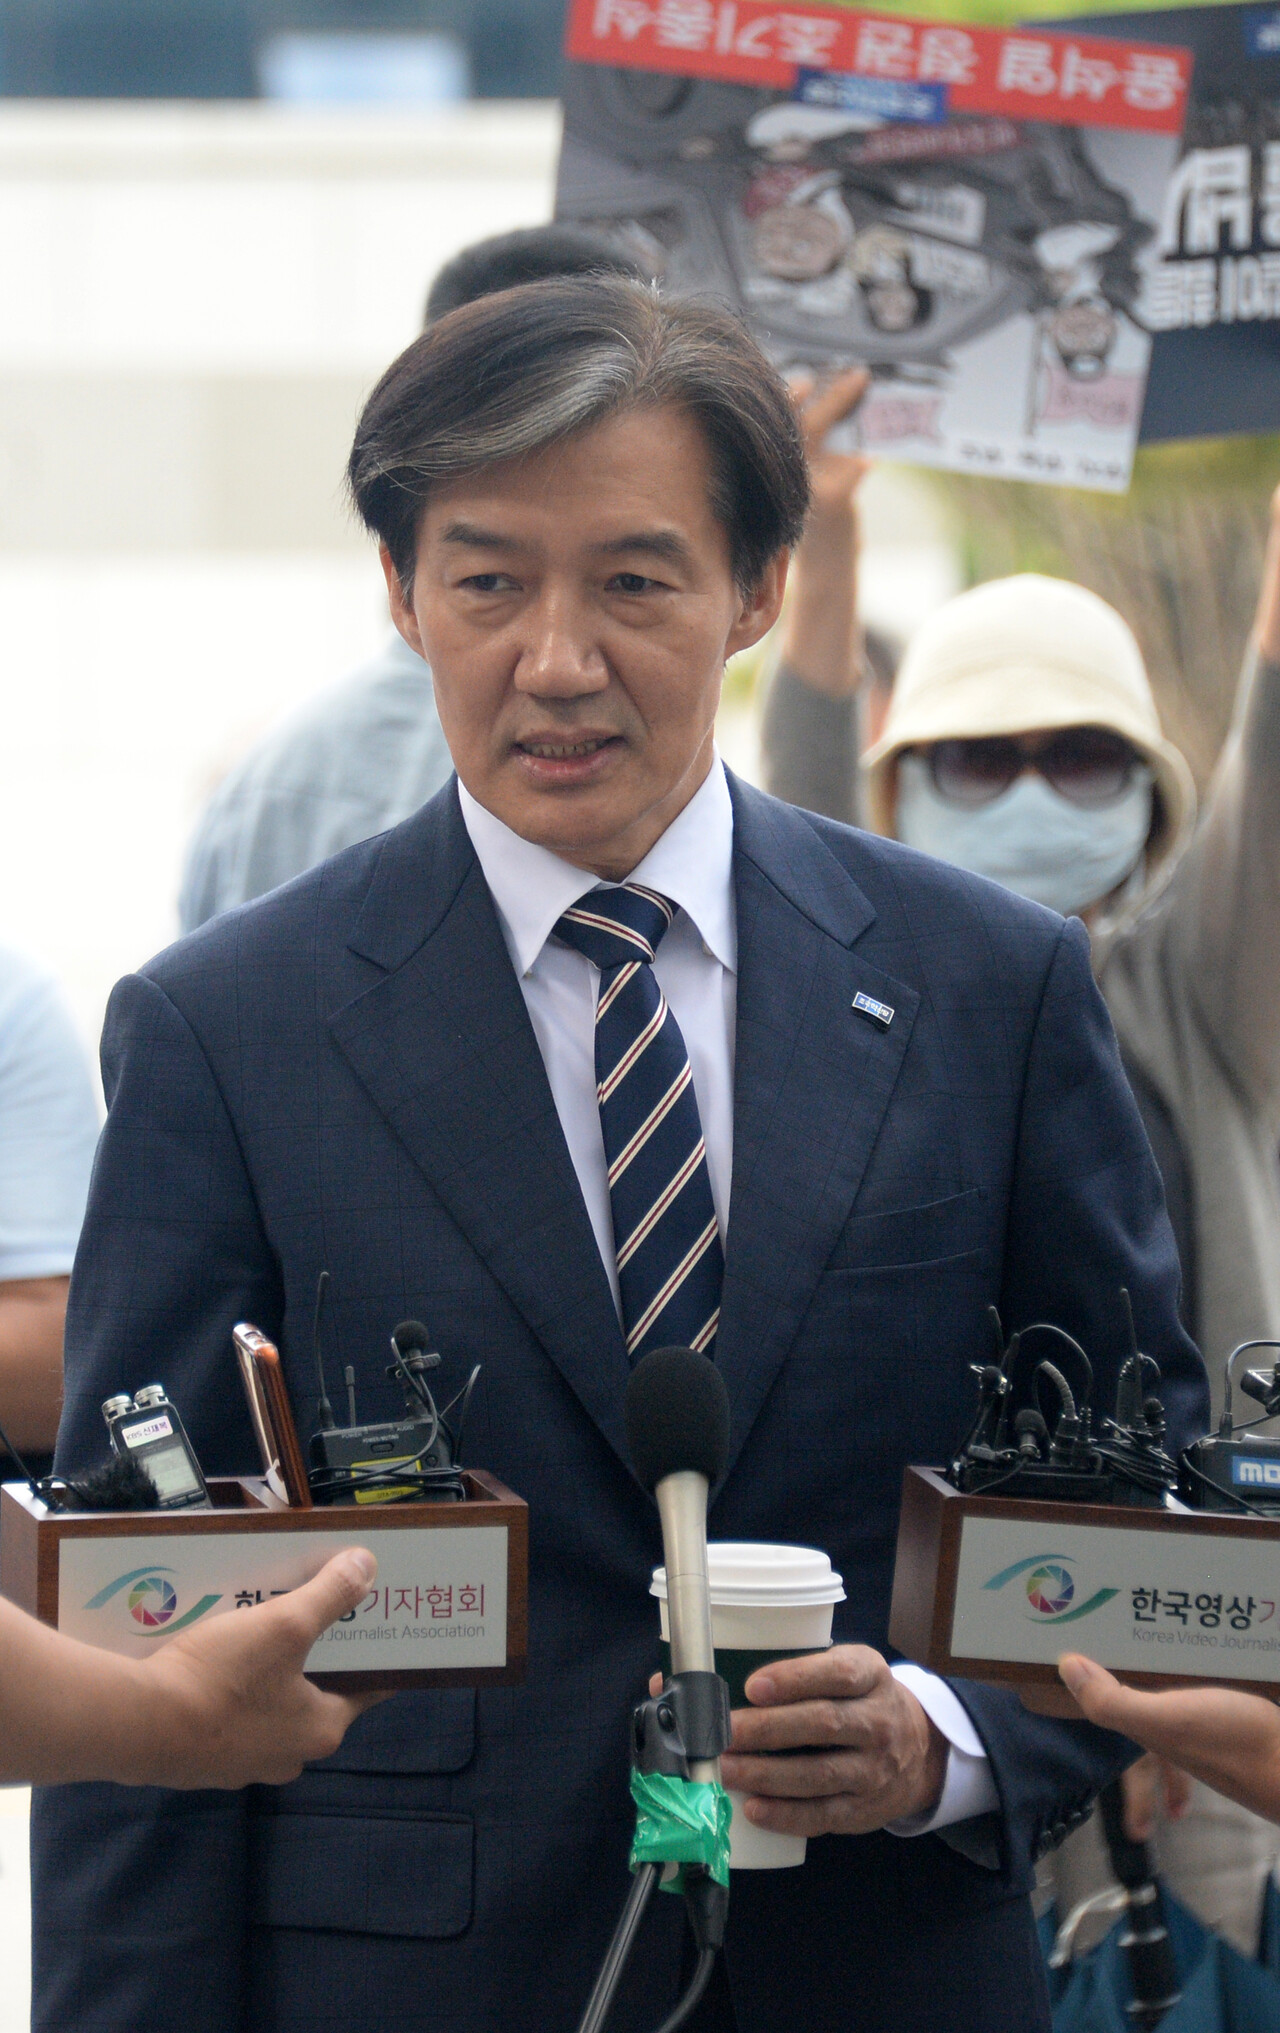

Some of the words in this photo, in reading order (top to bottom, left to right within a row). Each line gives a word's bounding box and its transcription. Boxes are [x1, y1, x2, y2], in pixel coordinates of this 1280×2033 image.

[854, 19, 980, 86] 정권
[997, 36, 1187, 111] 윤석열
[328, 1626, 398, 1641] Journalist
[402, 1624, 485, 1640] Association
[1133, 1628, 1175, 1644] Korea
[1177, 1631, 1218, 1647] Video
